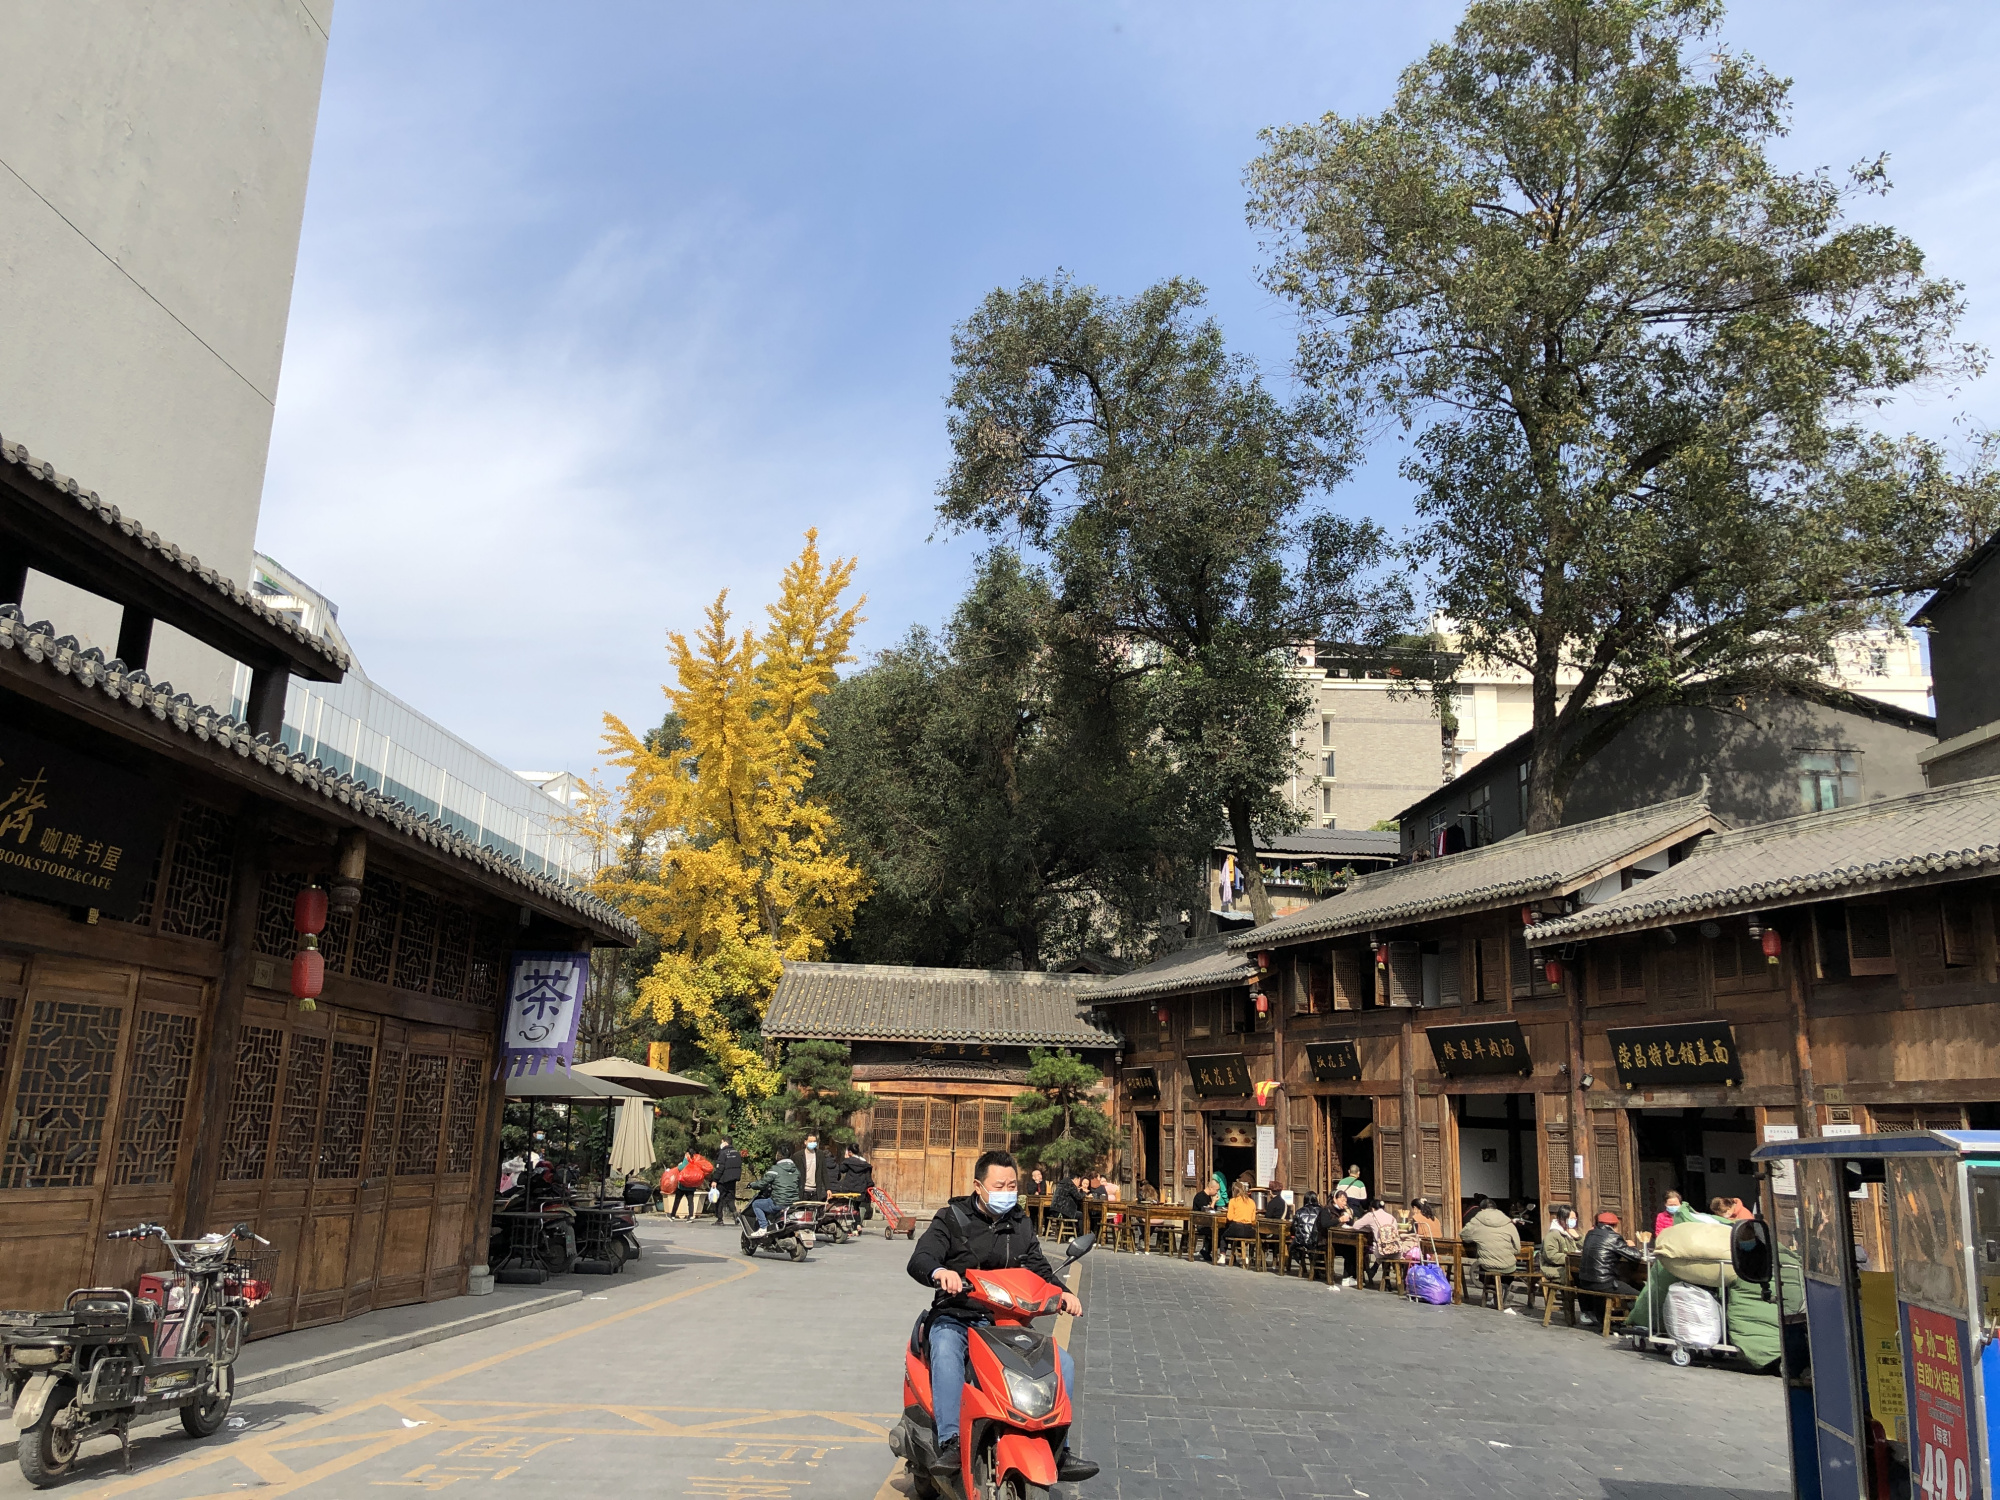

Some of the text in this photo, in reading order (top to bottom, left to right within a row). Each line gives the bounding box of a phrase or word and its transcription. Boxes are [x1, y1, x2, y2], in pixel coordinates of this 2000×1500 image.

[40, 827, 123, 872] 咖啡书屋
[515, 968, 573, 1020] 茶
[1924, 1328, 1958, 1366] 孙二娘
[1916, 1361, 1961, 1400] 自助火锅城
